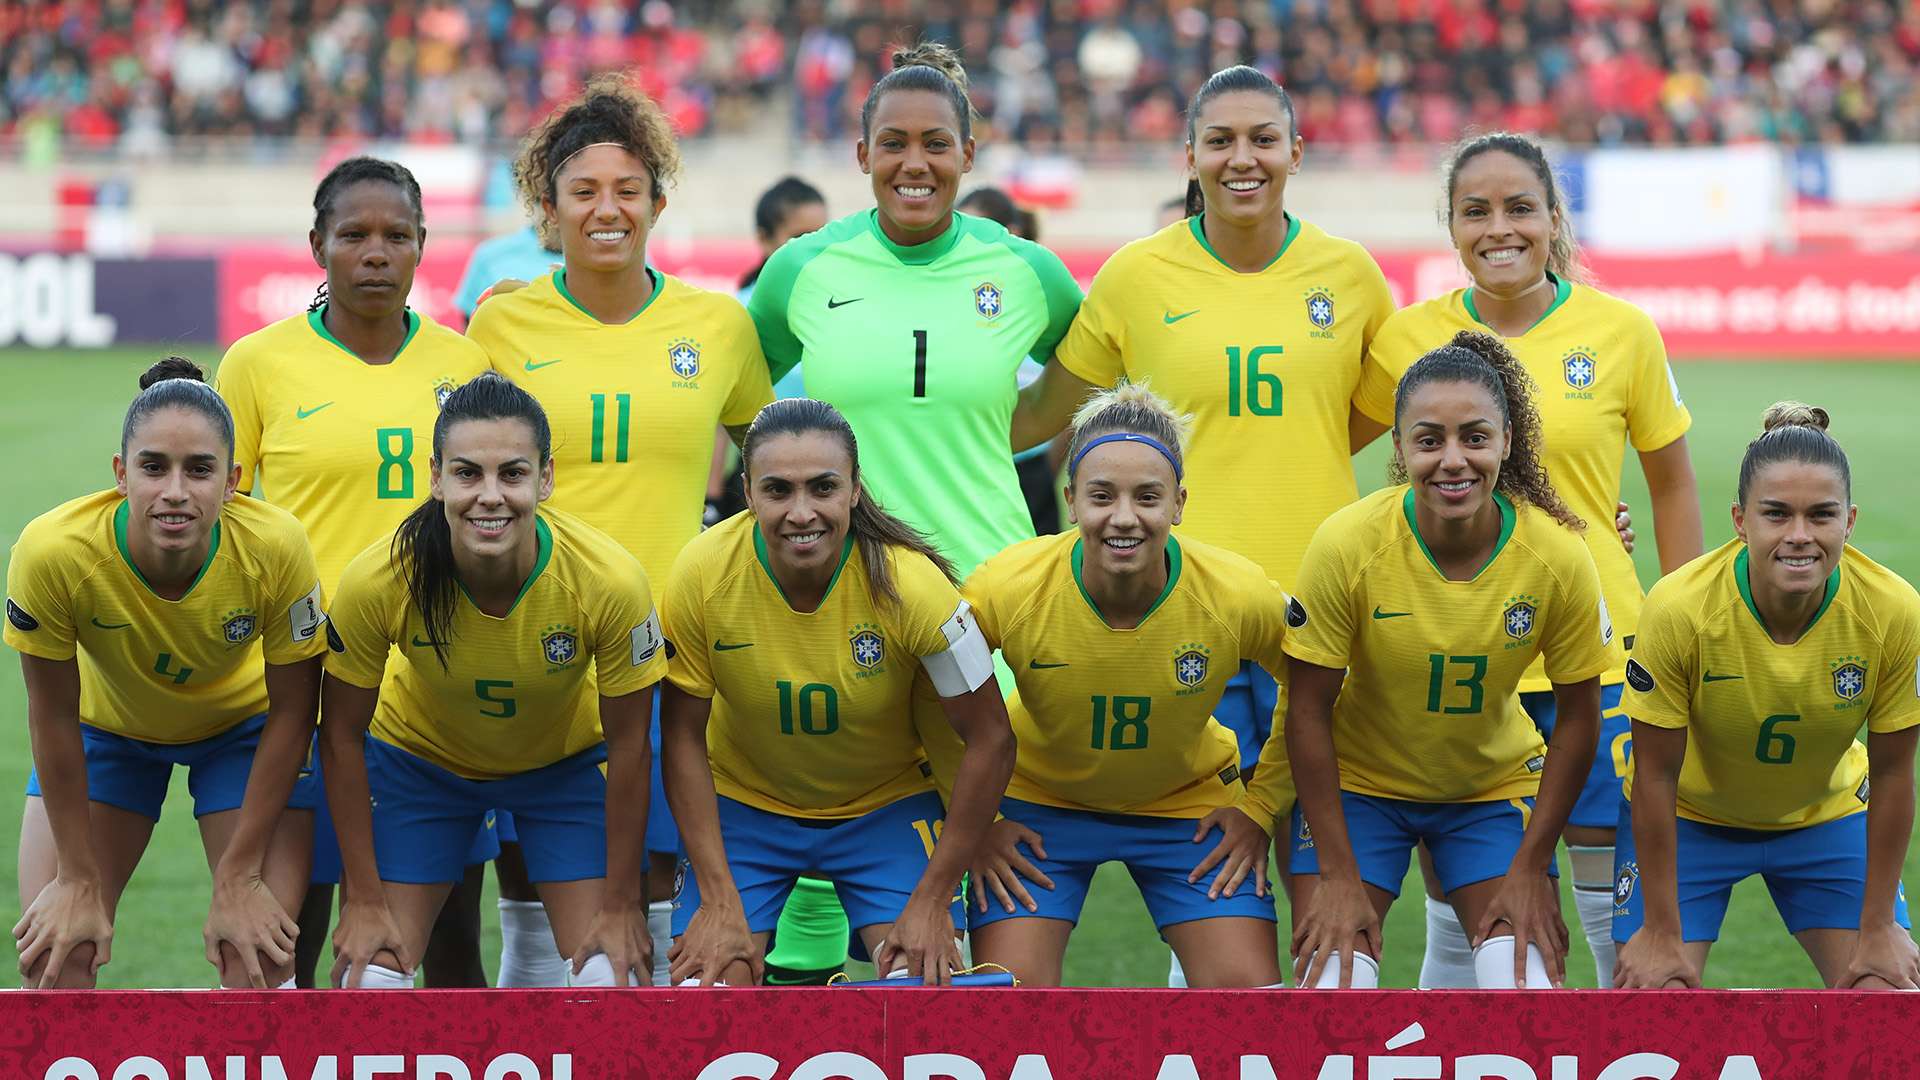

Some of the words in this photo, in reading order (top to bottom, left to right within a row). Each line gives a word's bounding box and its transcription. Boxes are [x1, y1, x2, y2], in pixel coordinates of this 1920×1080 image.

[913, 330, 927, 397] 1
[1226, 345, 1283, 416] 16
[590, 394, 630, 463] 11
[376, 428, 414, 499] 8
[154, 653, 193, 684] 4
[1427, 654, 1488, 714] 13
[475, 679, 517, 718] 5
[776, 680, 839, 735] 10
[1091, 695, 1151, 750] 18
[1755, 714, 1800, 764] 6
[911, 819, 944, 860] 1
